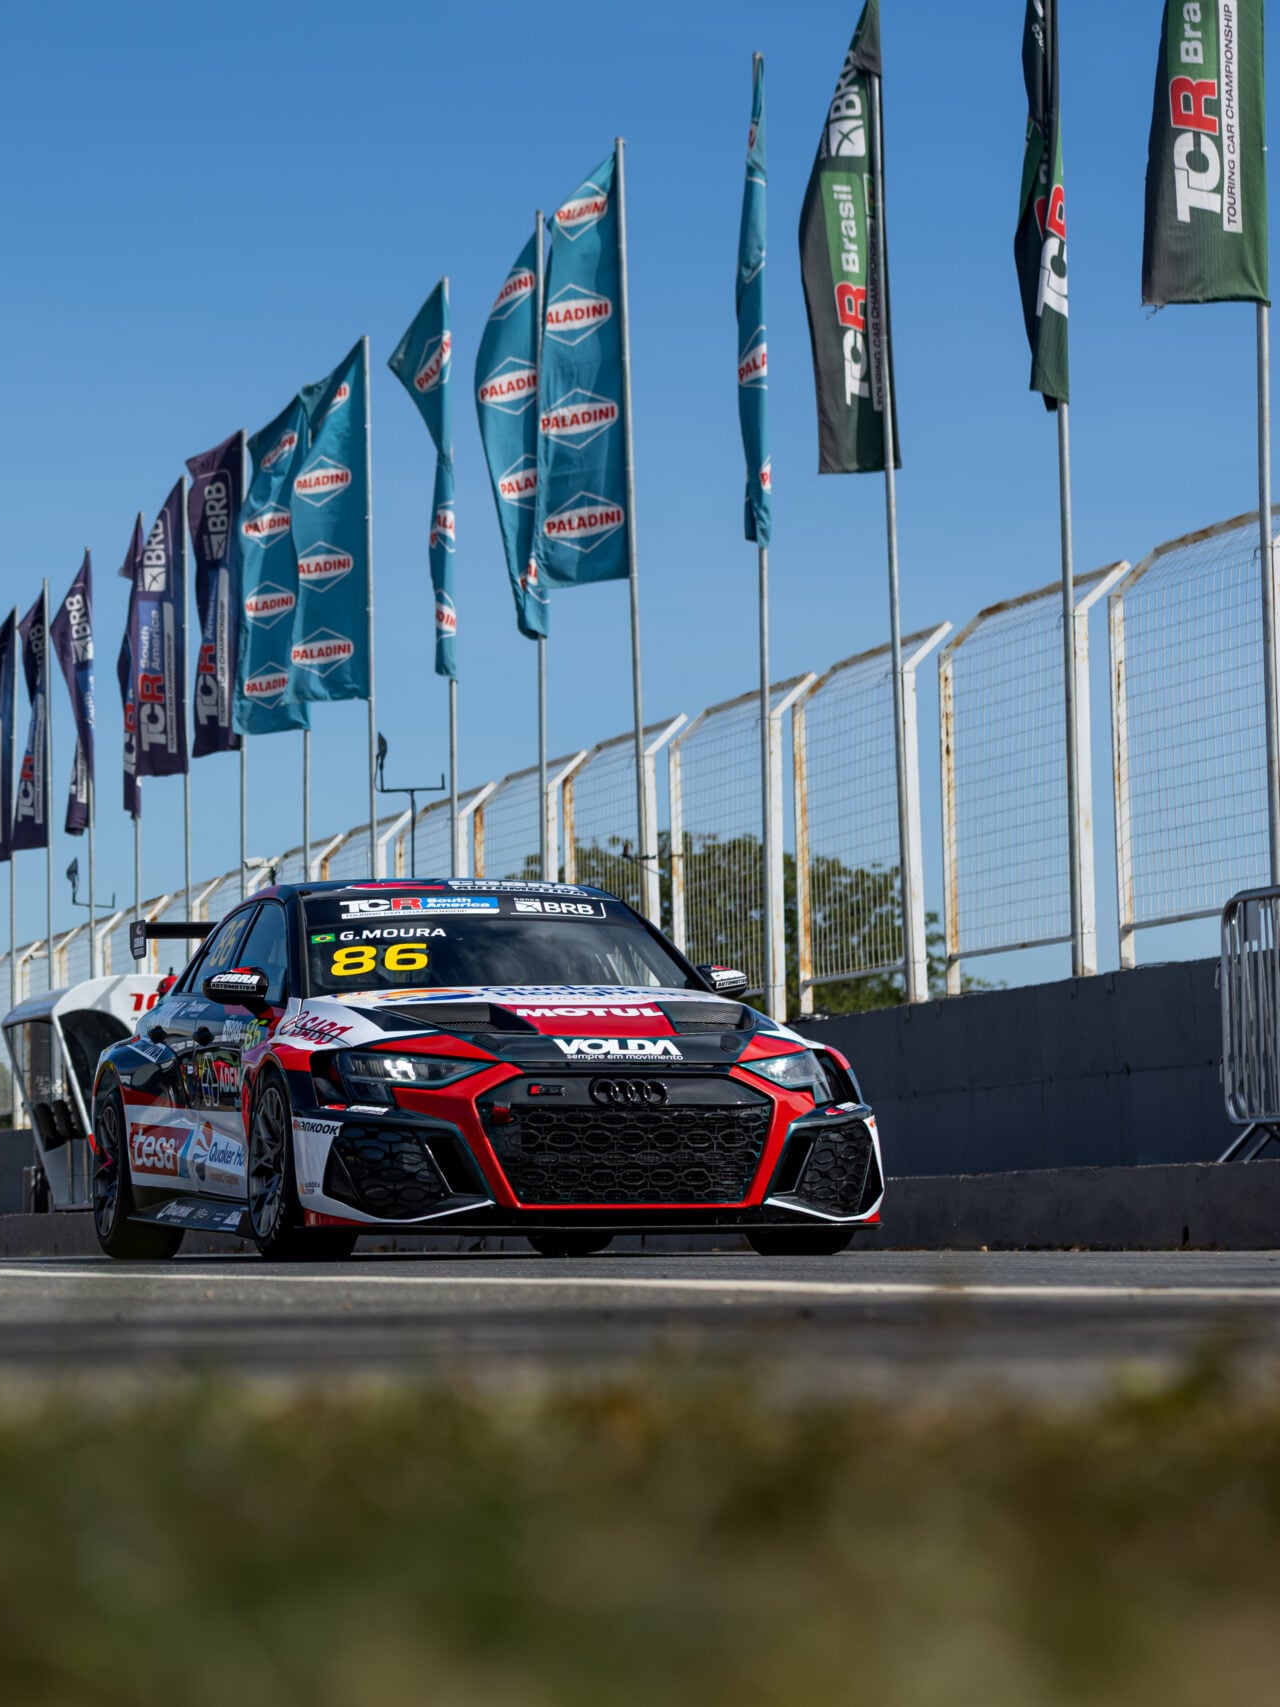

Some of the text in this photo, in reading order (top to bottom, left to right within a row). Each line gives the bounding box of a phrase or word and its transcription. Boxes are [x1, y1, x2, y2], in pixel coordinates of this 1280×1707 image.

[1223, 3, 1239, 224] TOURING CAR CHAMPIONSHIP
[1169, 75, 1221, 223] TCR
[831, 183, 861, 274] Brasil
[834, 281, 870, 406] TCR
[541, 406, 615, 431] PALADINI
[296, 471, 349, 491] PALADINI
[204, 482, 227, 532] BRB
[545, 510, 621, 534] PALADINI
[139, 625, 150, 669] South
[150, 610, 161, 670] America
[293, 643, 351, 661] PALADINI
[138, 673, 166, 752] TCR
[340, 898, 422, 913] TCR
[543, 902, 594, 915] BRB
[339, 928, 447, 941] G.MOURA
[330, 943, 429, 976] 86
[212, 974, 261, 985] COBRA
[516, 1007, 666, 1018] MOTUL
[553, 1039, 681, 1056] VOLDA
[567, 1053, 604, 1061] sempre
[623, 1053, 684, 1061] movimento
[132, 1128, 179, 1170] tesa
